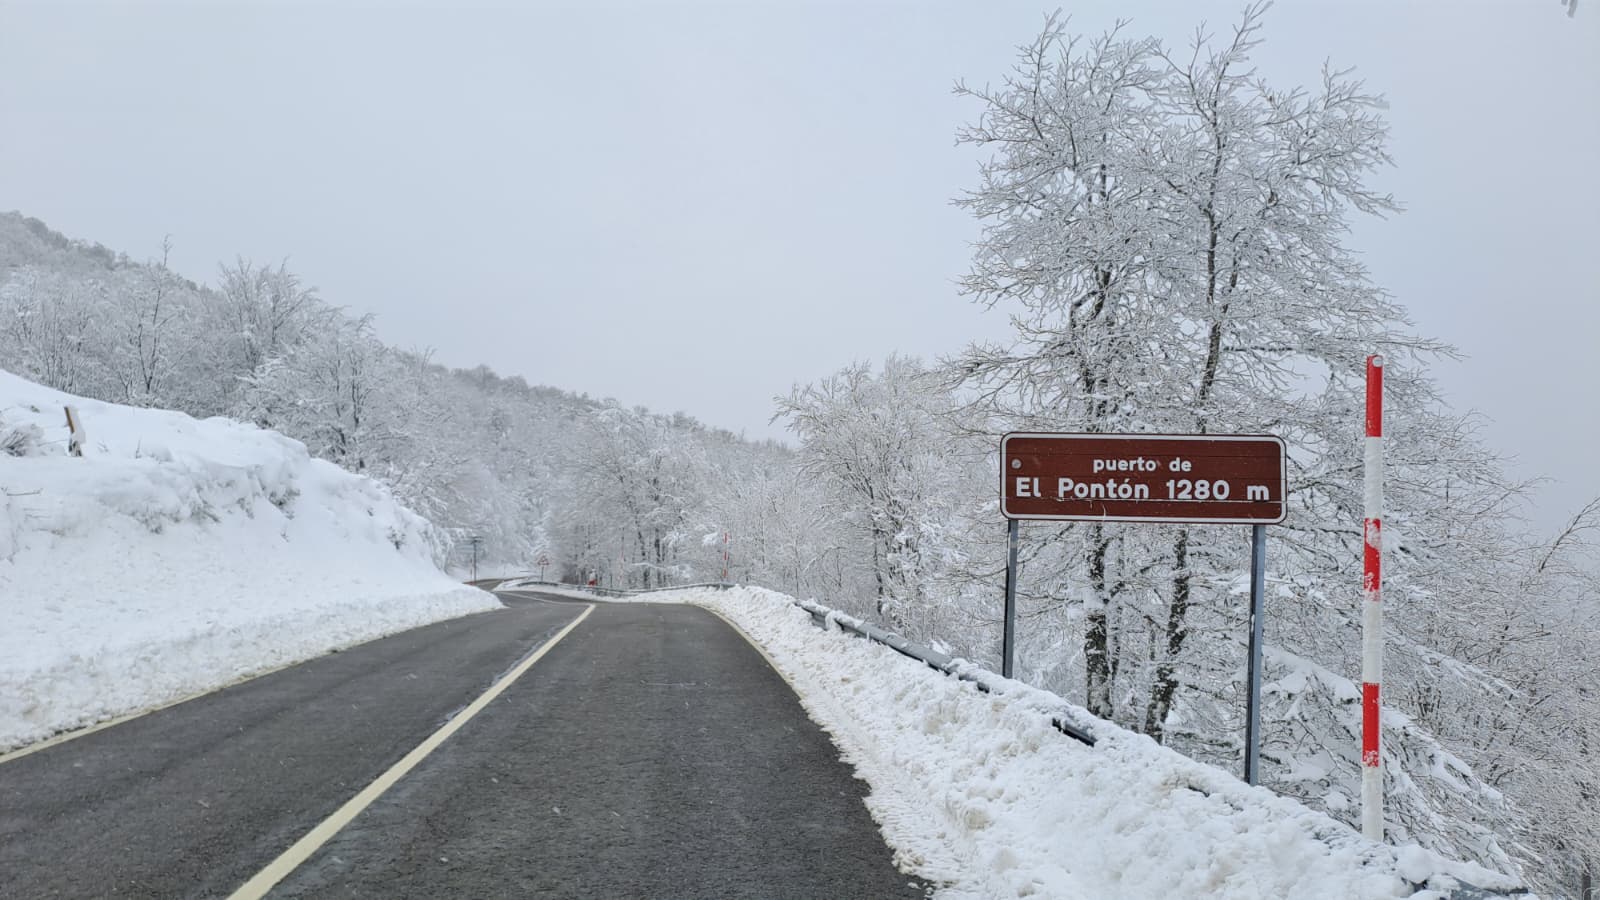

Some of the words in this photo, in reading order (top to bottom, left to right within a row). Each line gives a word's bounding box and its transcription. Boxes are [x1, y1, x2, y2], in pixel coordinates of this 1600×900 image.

[1093, 456, 1156, 473] puerto
[1169, 457, 1192, 472] de
[1016, 477, 1041, 497] El
[1058, 477, 1149, 499] Pontón
[1166, 479, 1230, 500] 1280
[1247, 484, 1270, 501] m
